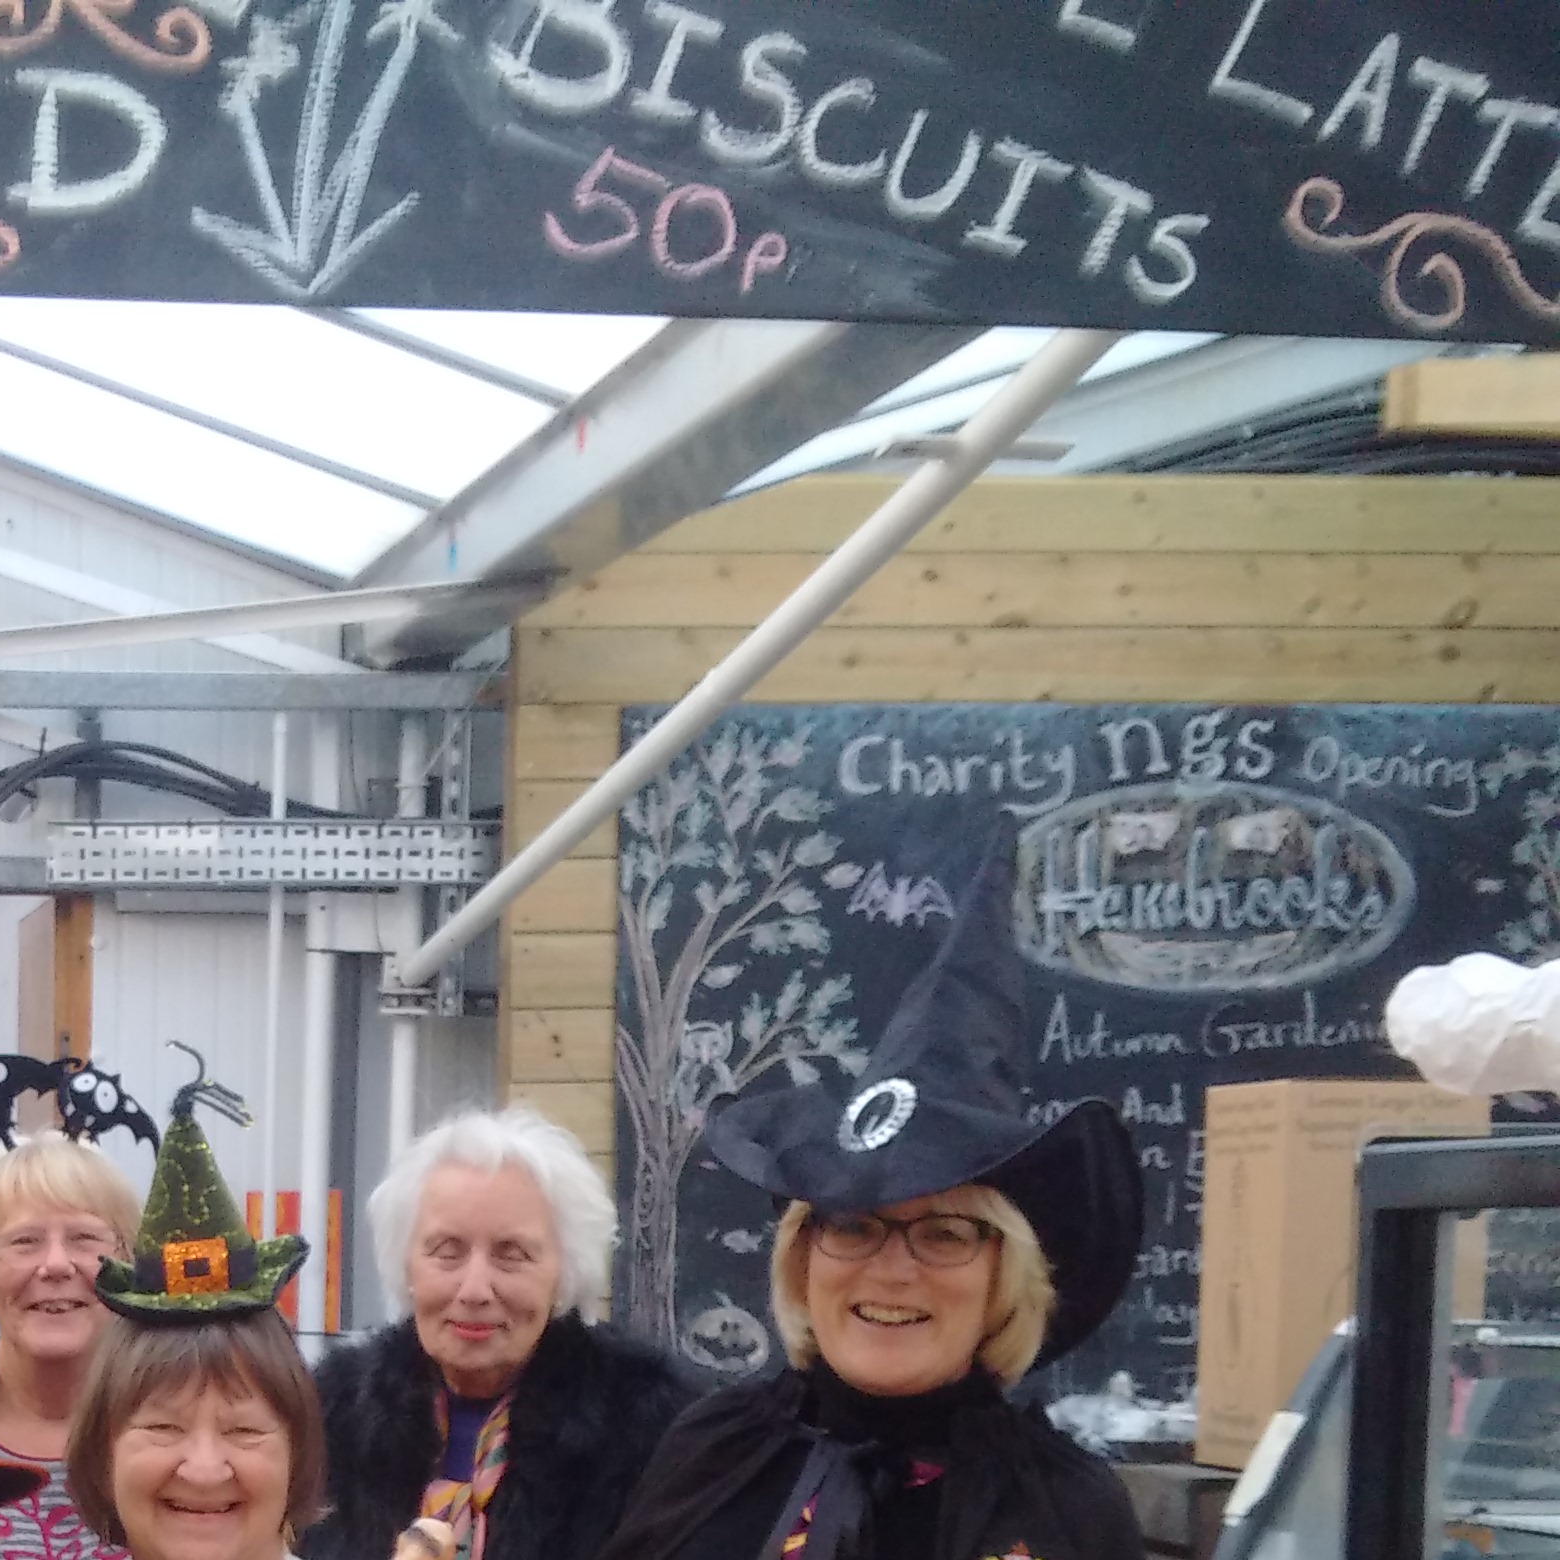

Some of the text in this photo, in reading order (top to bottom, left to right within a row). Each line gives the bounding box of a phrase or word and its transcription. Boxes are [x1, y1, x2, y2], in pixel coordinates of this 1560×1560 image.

[490, 0, 1212, 301] BISCUITS
[544, 144, 788, 294] 50p
[841, 705, 1478, 818] Charity ngs Opening
